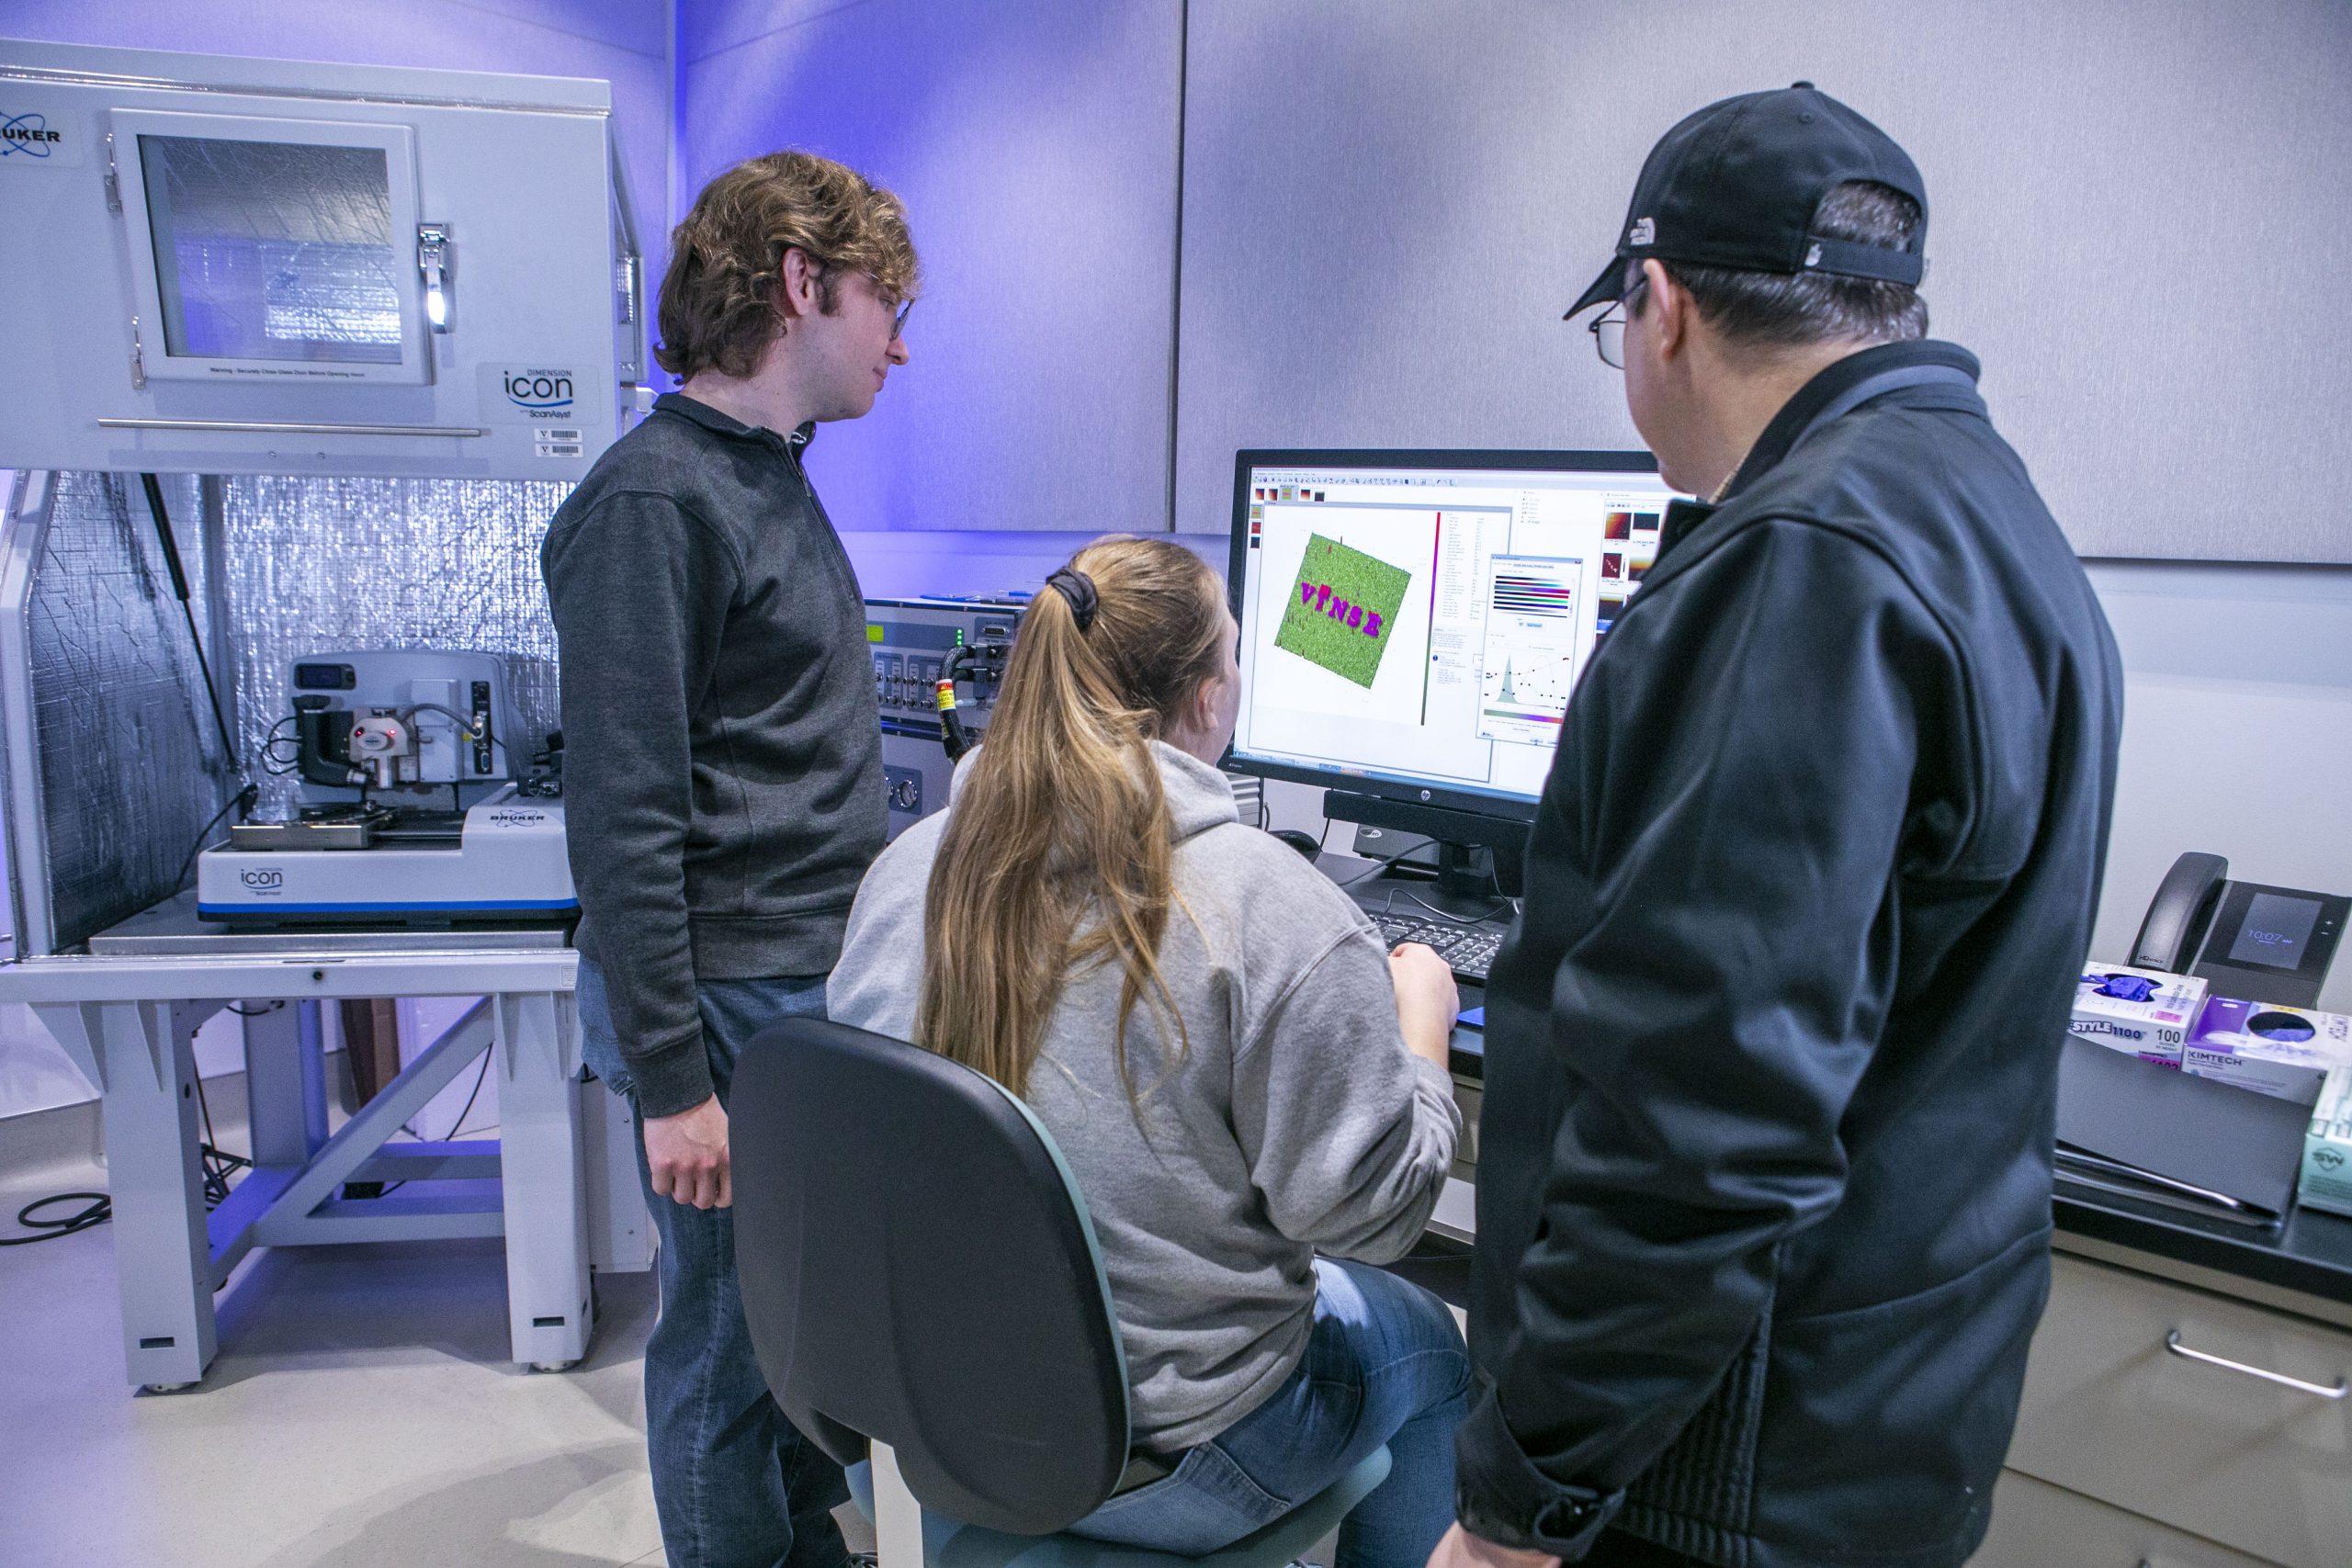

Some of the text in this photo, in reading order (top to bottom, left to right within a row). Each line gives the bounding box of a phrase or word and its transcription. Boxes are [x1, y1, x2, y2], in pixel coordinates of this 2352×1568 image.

[0, 129, 61, 142] UKER
[526, 368, 572, 378] DIMENSION
[503, 370, 573, 399] icon
[529, 410, 571, 420] ScanAsyst
[240, 868, 283, 885] icon
[2248, 929, 2284, 942] 10:07
[2112, 1026, 2142, 1040] 1100
[2156, 1029, 2181, 1043] 100
[2188, 1050, 2243, 1066] KIMTECH
